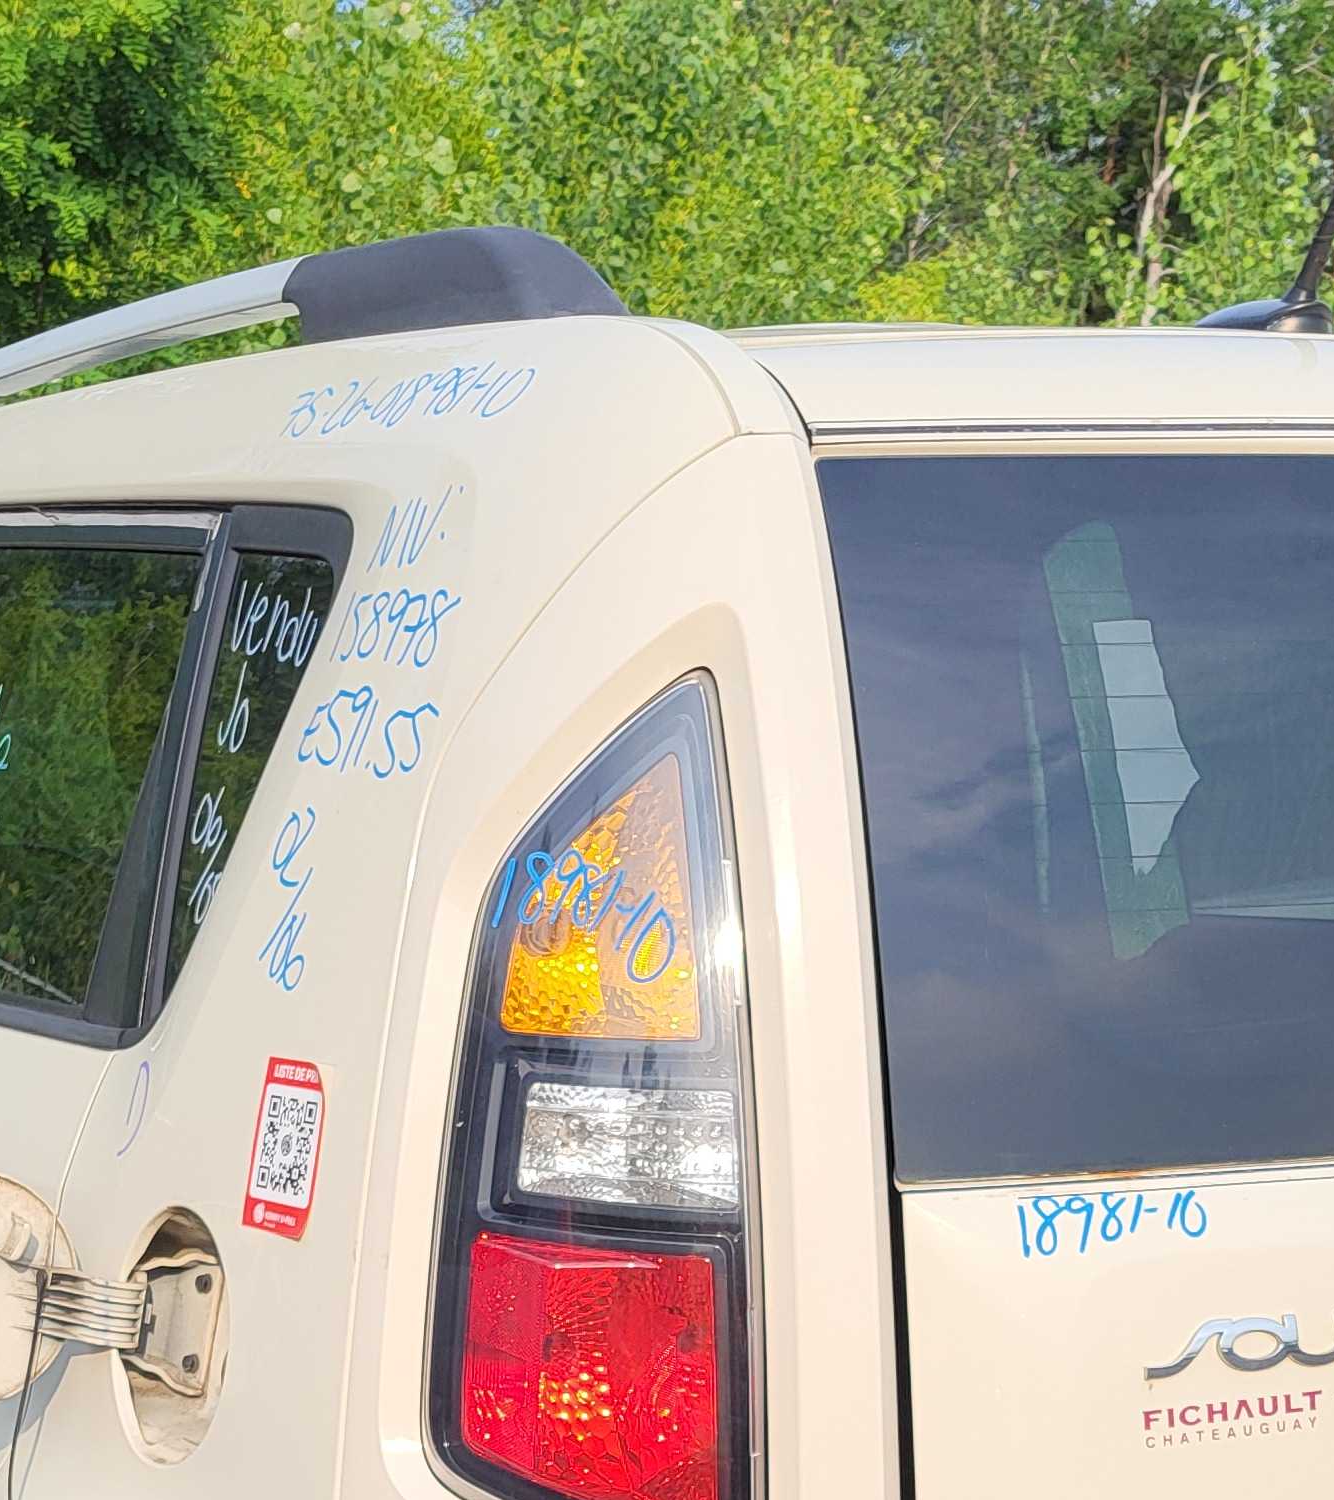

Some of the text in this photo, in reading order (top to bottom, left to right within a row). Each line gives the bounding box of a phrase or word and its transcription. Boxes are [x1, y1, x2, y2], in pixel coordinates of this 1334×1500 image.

[330, 586, 463, 668] 158978
[274, 1063, 295, 1080] LISTE
[294, 1067, 308, 1082] DE
[1017, 1189, 1207, 1258] 18981-10
[1142, 1389, 1323, 1431] FICHAULT
[1144, 1416, 1319, 1449] CHATEAUGUAY
